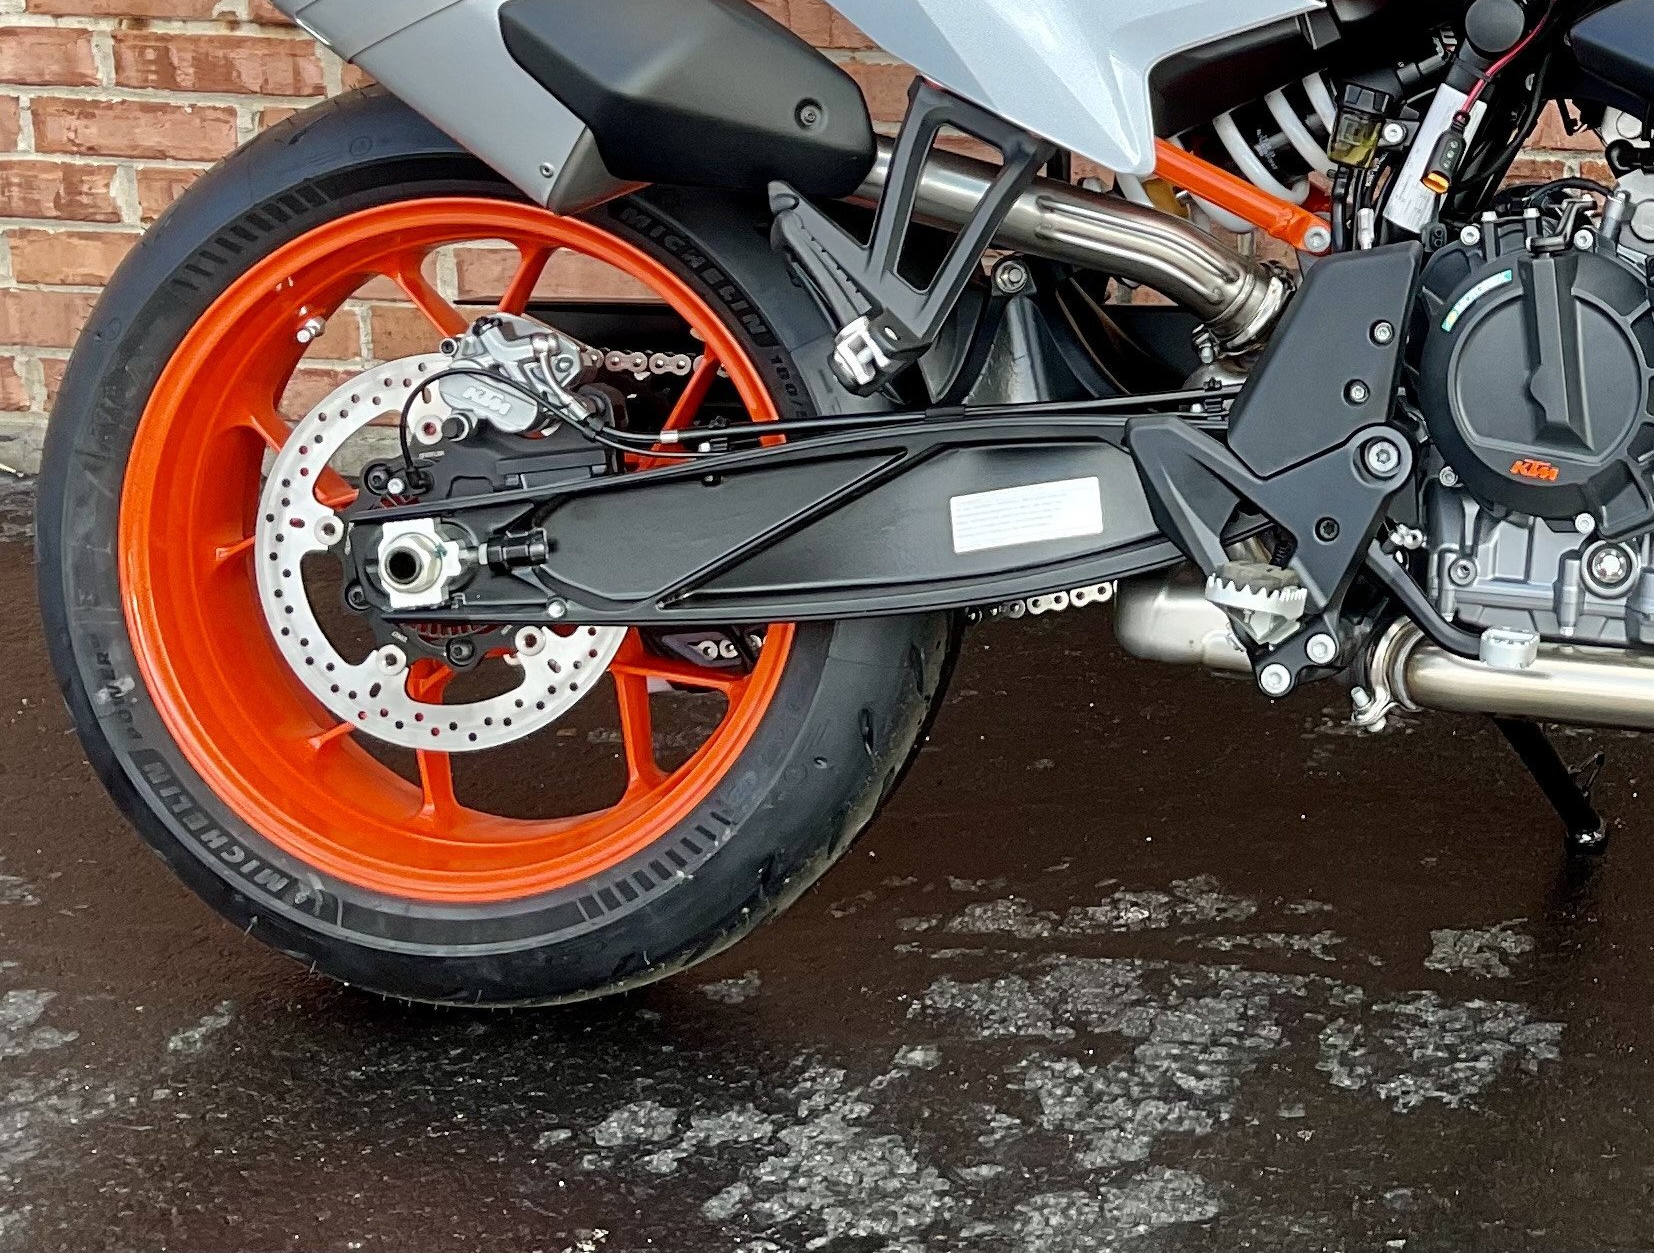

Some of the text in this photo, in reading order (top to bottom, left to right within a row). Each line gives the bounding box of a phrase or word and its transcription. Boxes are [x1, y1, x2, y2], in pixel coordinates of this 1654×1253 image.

[619, 207, 769, 336] MICHELIN
[462, 386, 511, 415] KTM
[1509, 459, 1560, 481] KTM
[141, 760, 291, 893] MICHELIN
